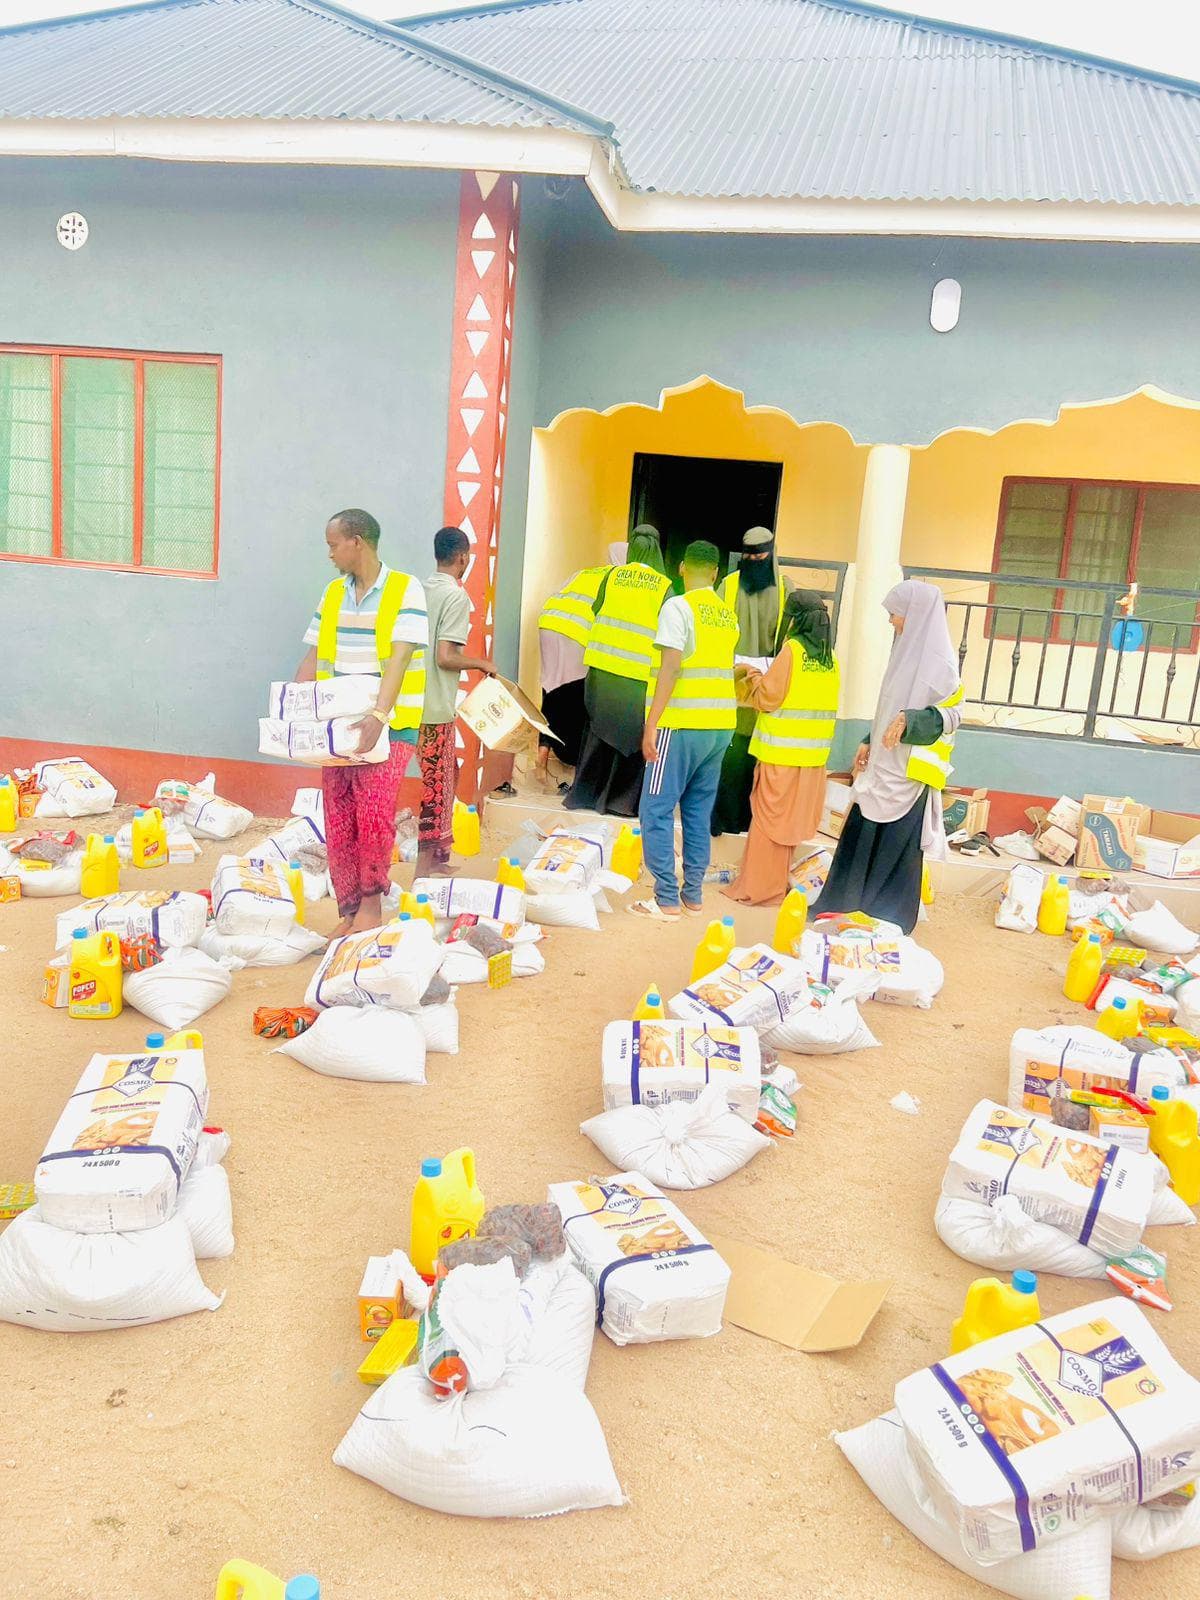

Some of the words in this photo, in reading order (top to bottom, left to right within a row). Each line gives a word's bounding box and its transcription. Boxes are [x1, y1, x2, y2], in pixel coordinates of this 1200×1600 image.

[613, 577, 658, 591] ORGANIZATION
[617, 569, 637, 580] GREAT
[638, 571, 662, 584] NOBLE
[608, 1197, 638, 1209] COSMO
[1066, 1356, 1099, 1392] COSMO
[937, 1407, 947, 1420] 24
[943, 1418, 954, 1427] X
[949, 1423, 965, 1441] 500
[958, 1438, 969, 1449] g
